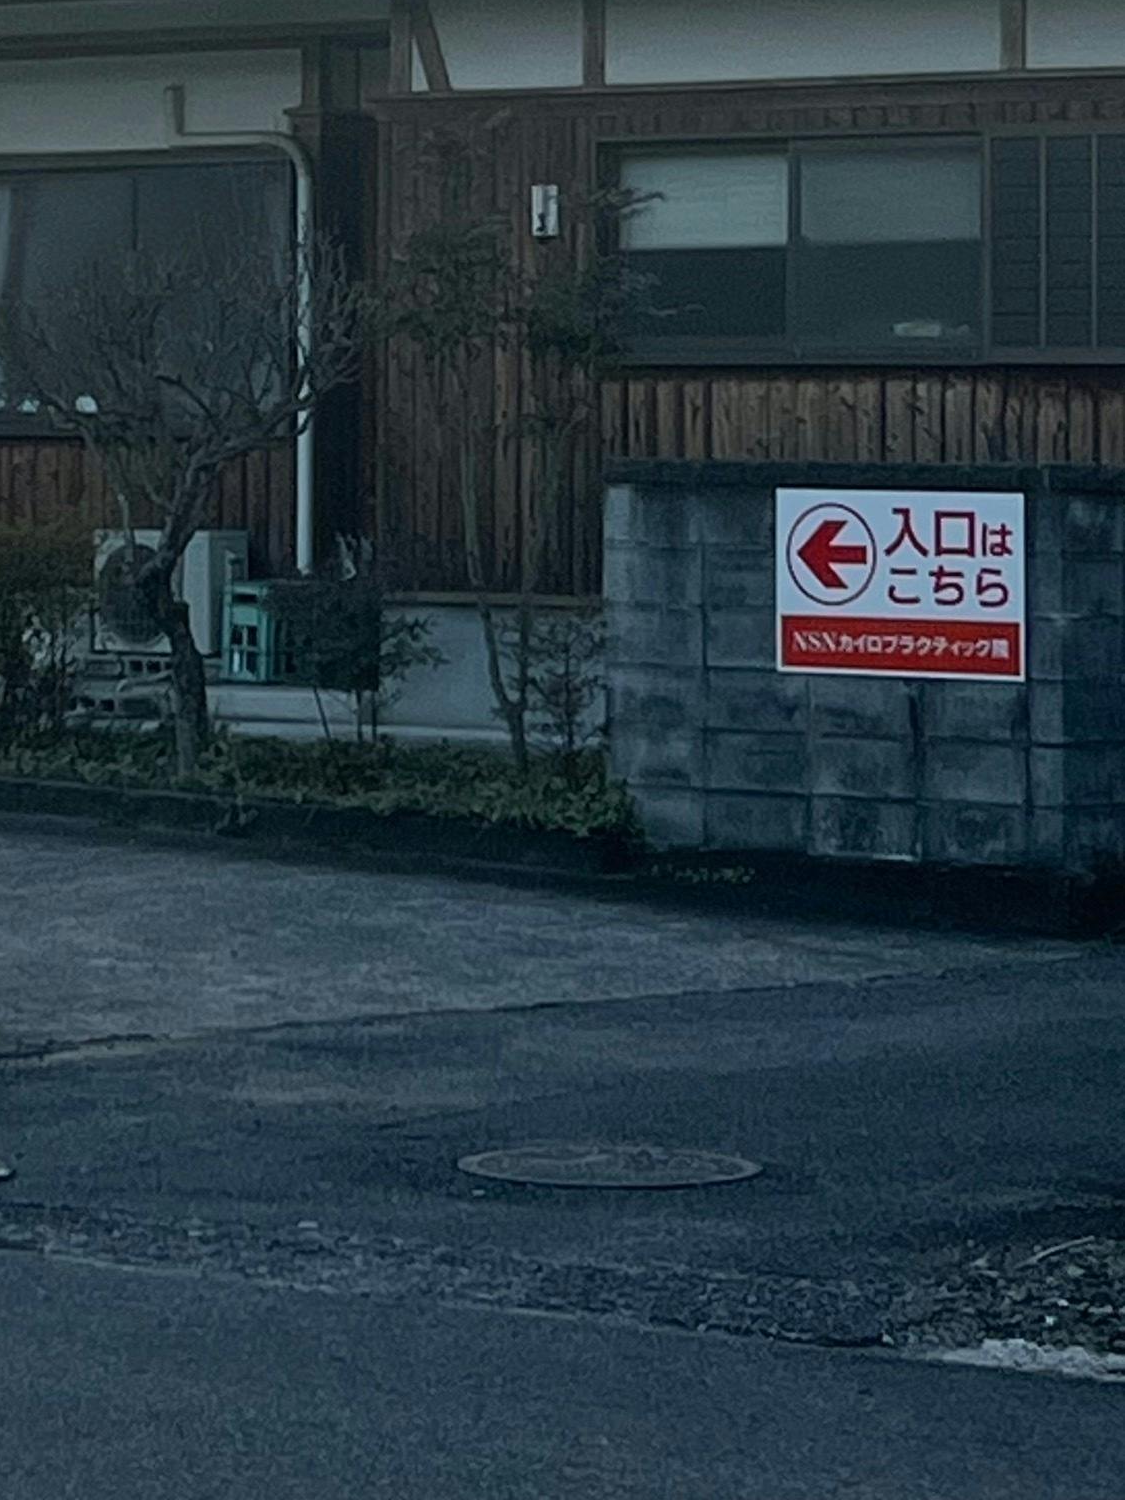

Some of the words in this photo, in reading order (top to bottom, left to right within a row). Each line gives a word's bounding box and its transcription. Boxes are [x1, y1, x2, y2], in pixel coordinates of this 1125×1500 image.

[883, 507, 1014, 558] 入口は
[887, 564, 1010, 608] こちら
